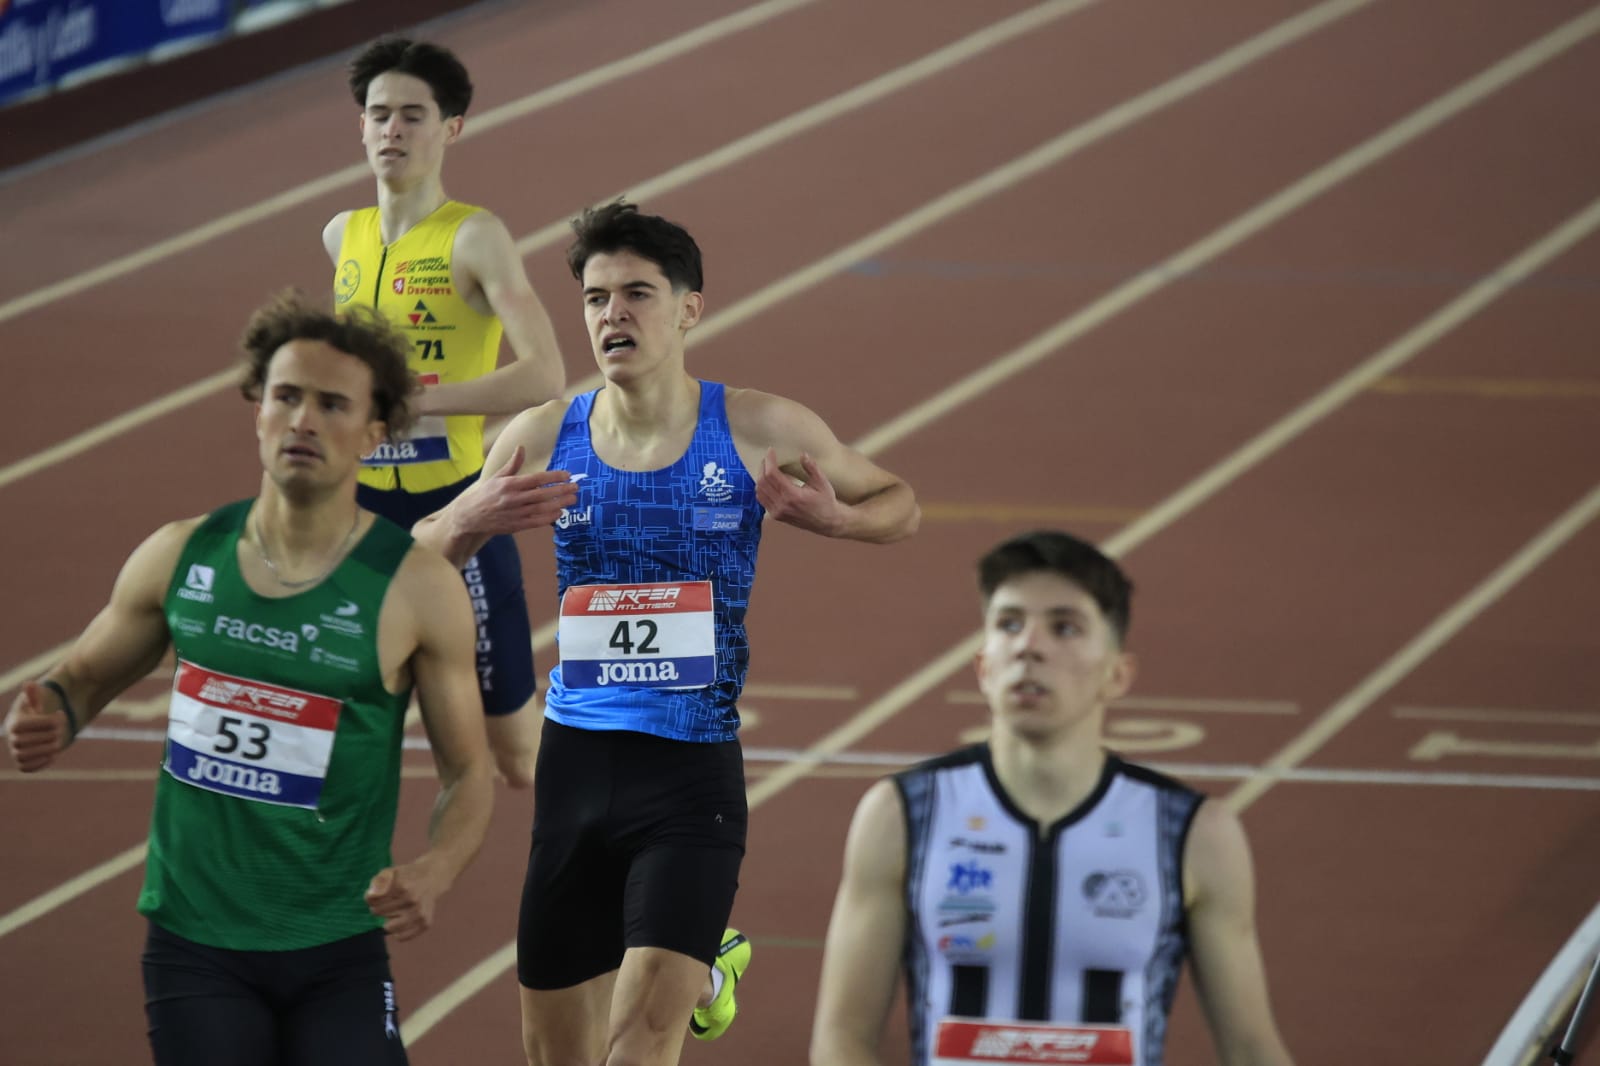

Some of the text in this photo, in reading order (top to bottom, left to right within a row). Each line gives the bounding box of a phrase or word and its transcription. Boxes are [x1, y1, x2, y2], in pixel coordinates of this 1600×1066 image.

[408, 275, 449, 287] Zaragoza
[617, 601, 677, 611] ATLETISMO
[620, 587, 681, 604] RFEA
[608, 618, 660, 655] 42
[596, 661, 679, 686] Joma
[213, 715, 271, 761] 53
[187, 754, 281, 796] Joma
